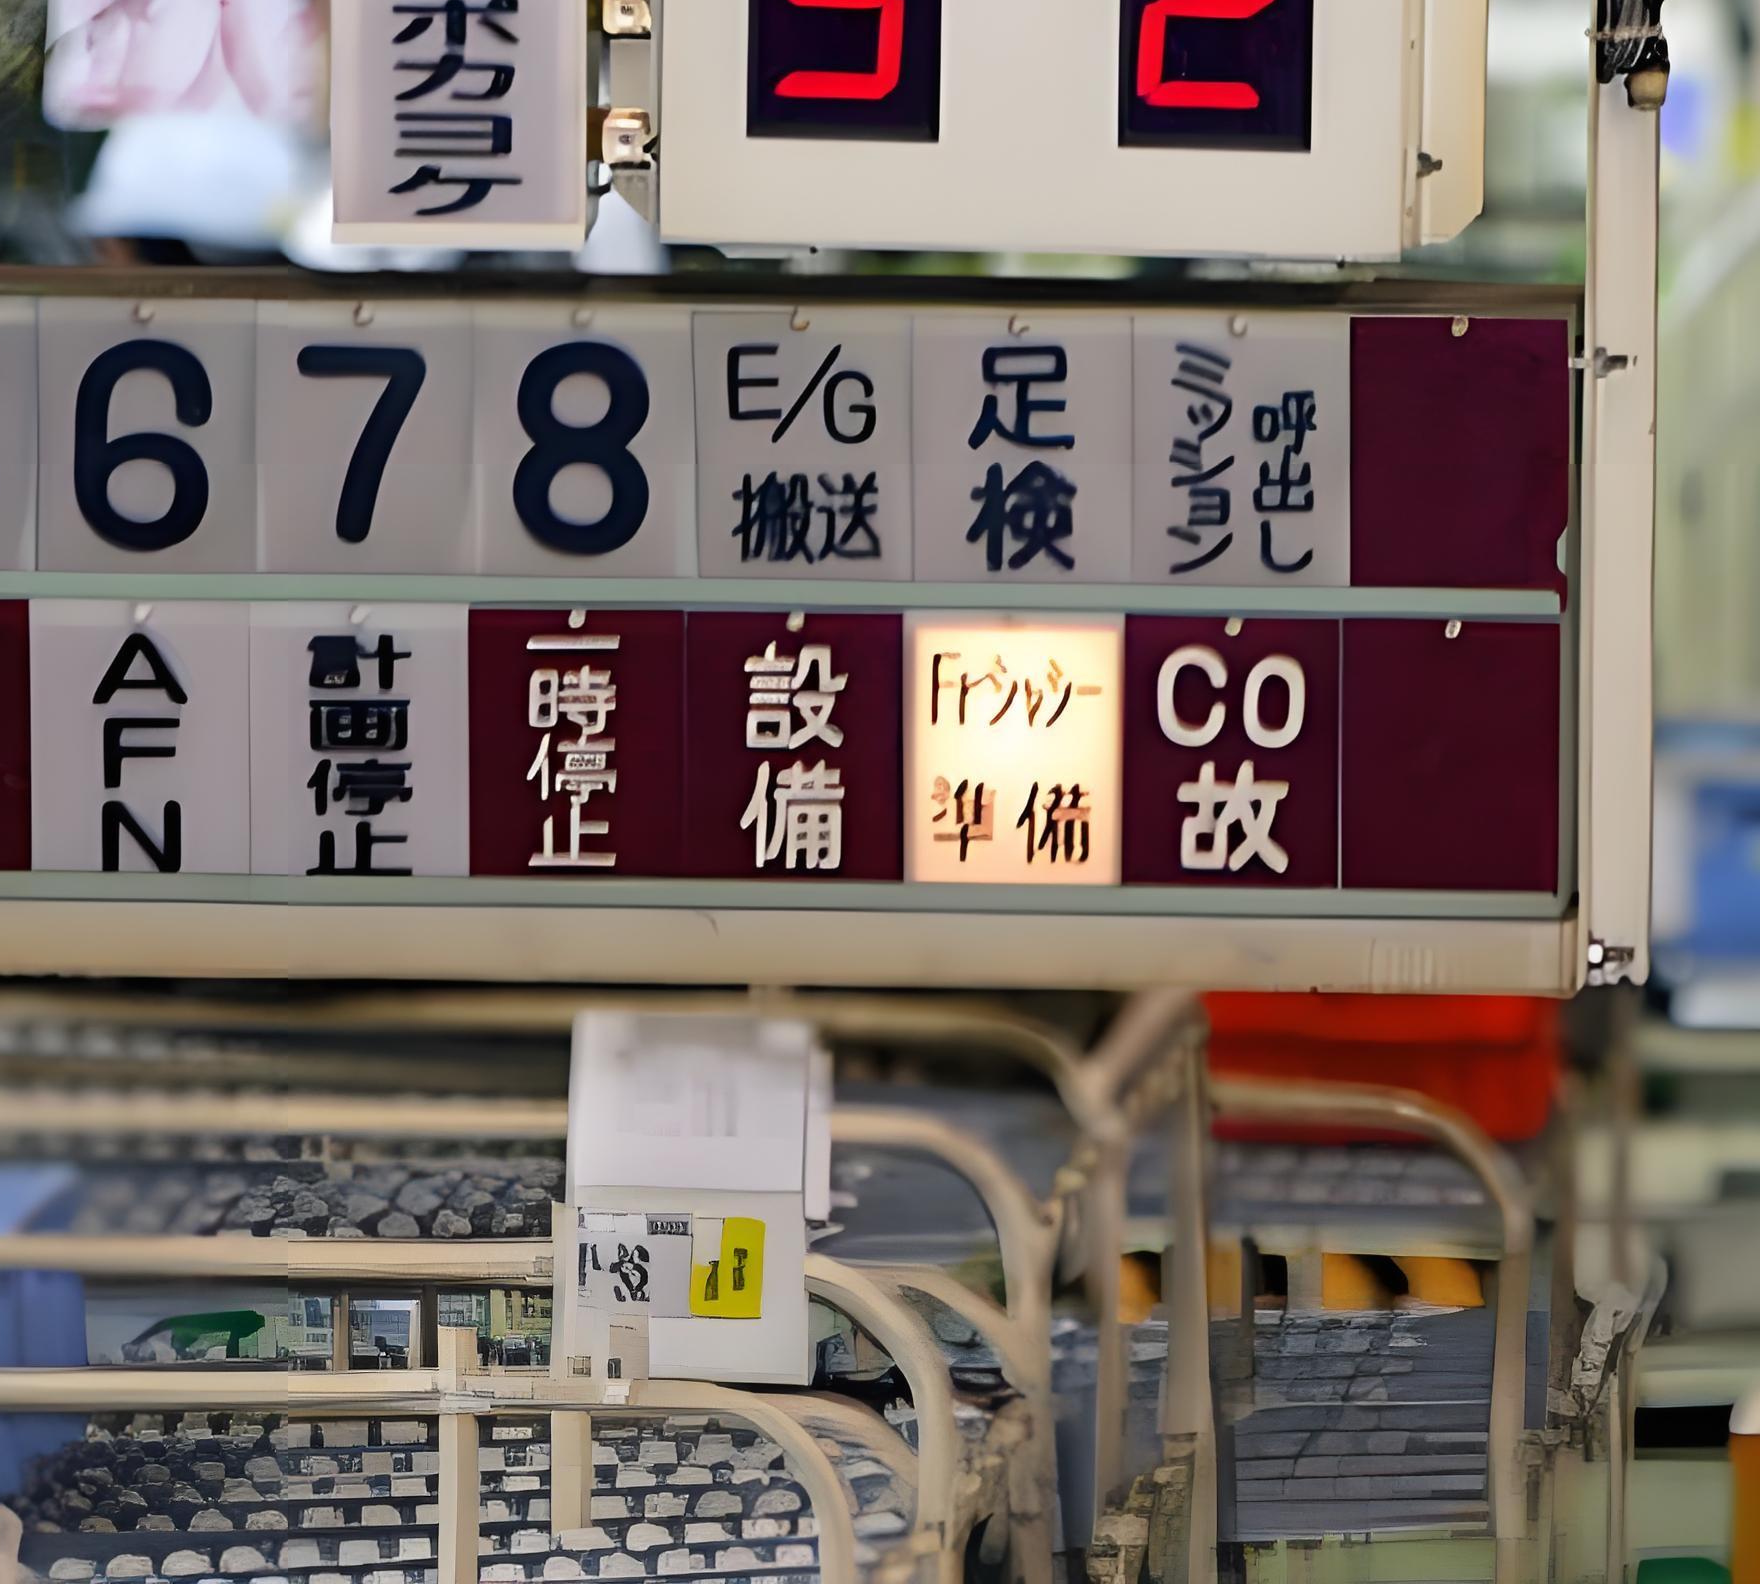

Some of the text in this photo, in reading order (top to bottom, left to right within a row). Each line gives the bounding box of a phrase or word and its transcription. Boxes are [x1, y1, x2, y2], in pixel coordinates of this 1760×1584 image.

[73, 339, 213, 552] 6
[297, 344, 427, 544] 7
[512, 341, 650, 555] 8
[727, 344, 877, 444] E/G
[1176, 758, 1290, 875] 故
